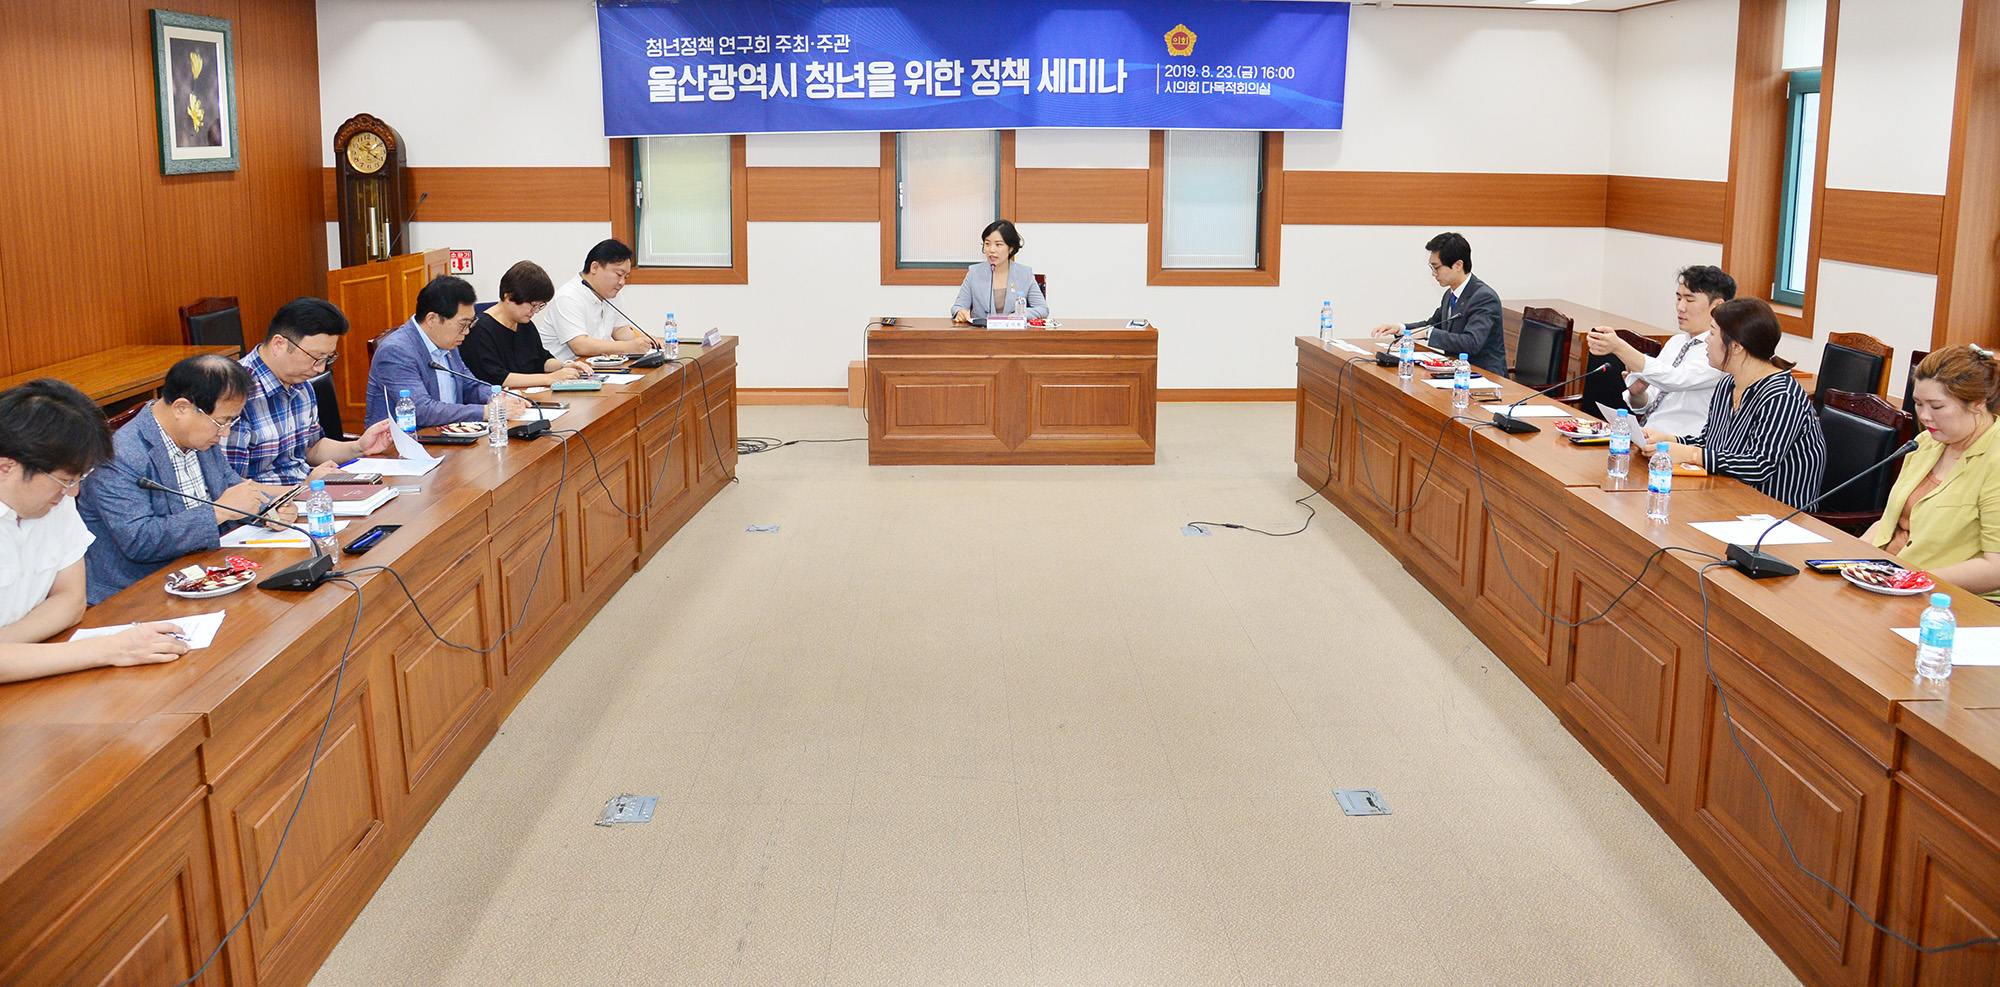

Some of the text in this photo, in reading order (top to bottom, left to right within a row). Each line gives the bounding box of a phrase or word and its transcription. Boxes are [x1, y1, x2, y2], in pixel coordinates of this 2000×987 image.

[645, 34, 852, 58] 청년정책 연구회 주최·주관
[1172, 36, 1190, 45] 의회
[647, 57, 1128, 103] 울산광역시 청년을 위한 정책 세미나
[1164, 64, 1296, 80] 2019. 8. 23.(금) 16:00
[1164, 80, 1271, 96] 시의회 다목적회의실
